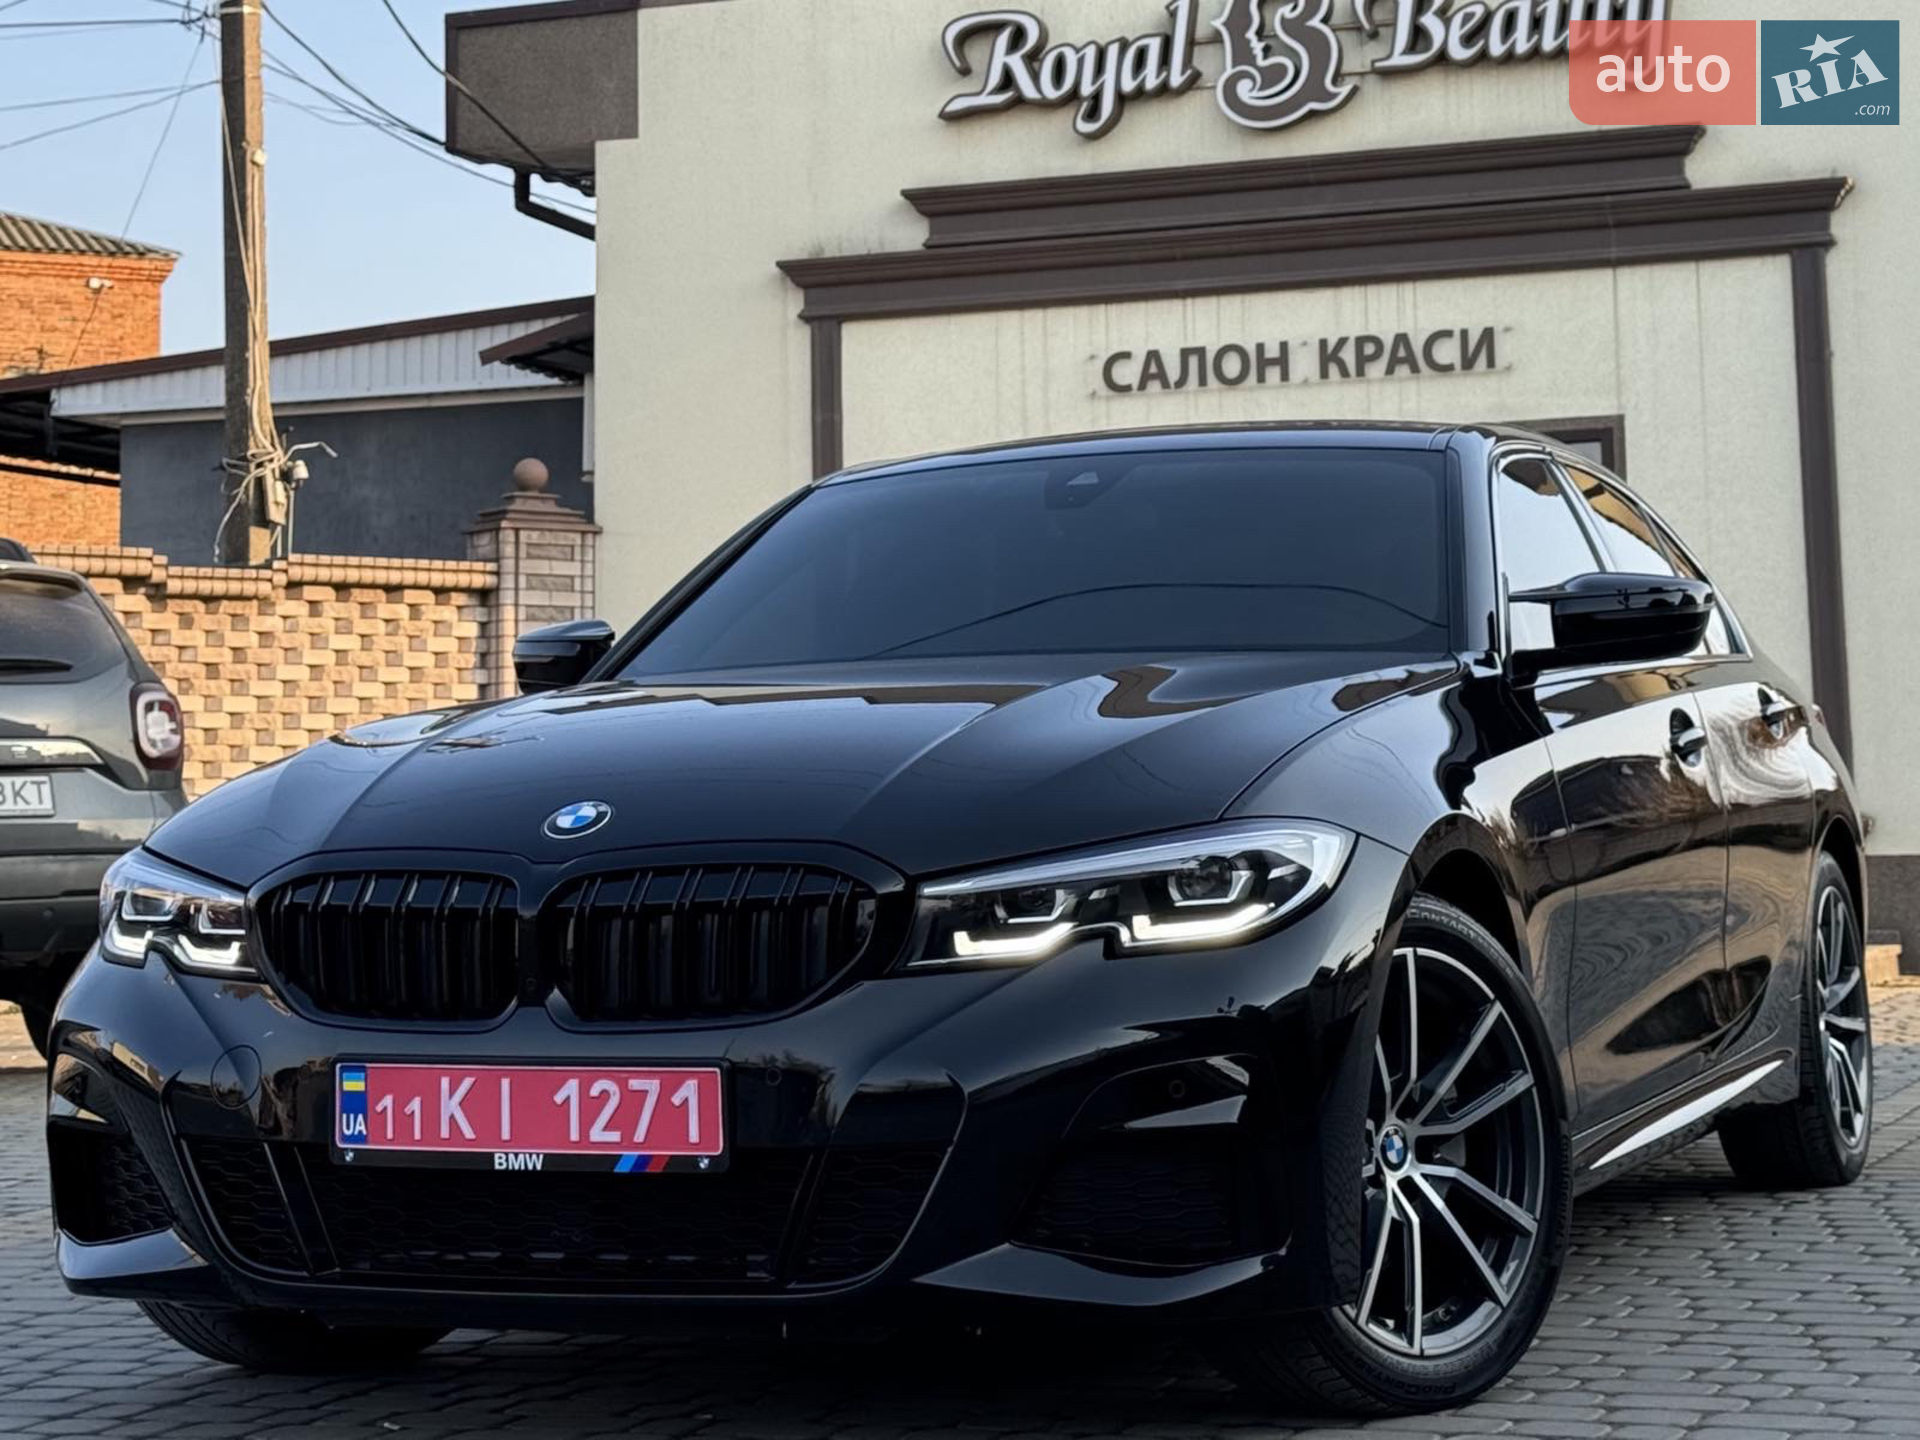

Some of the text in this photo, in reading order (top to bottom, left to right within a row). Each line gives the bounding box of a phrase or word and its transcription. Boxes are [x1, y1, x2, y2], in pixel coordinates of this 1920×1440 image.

[938, 0, 1201, 139] Royal
[1102, 326, 1497, 394] САЛОН КРАСИ
[342, 1114, 367, 1136] UA
[553, 1078, 700, 1144] 1271
[494, 1153, 544, 1171] BMW
